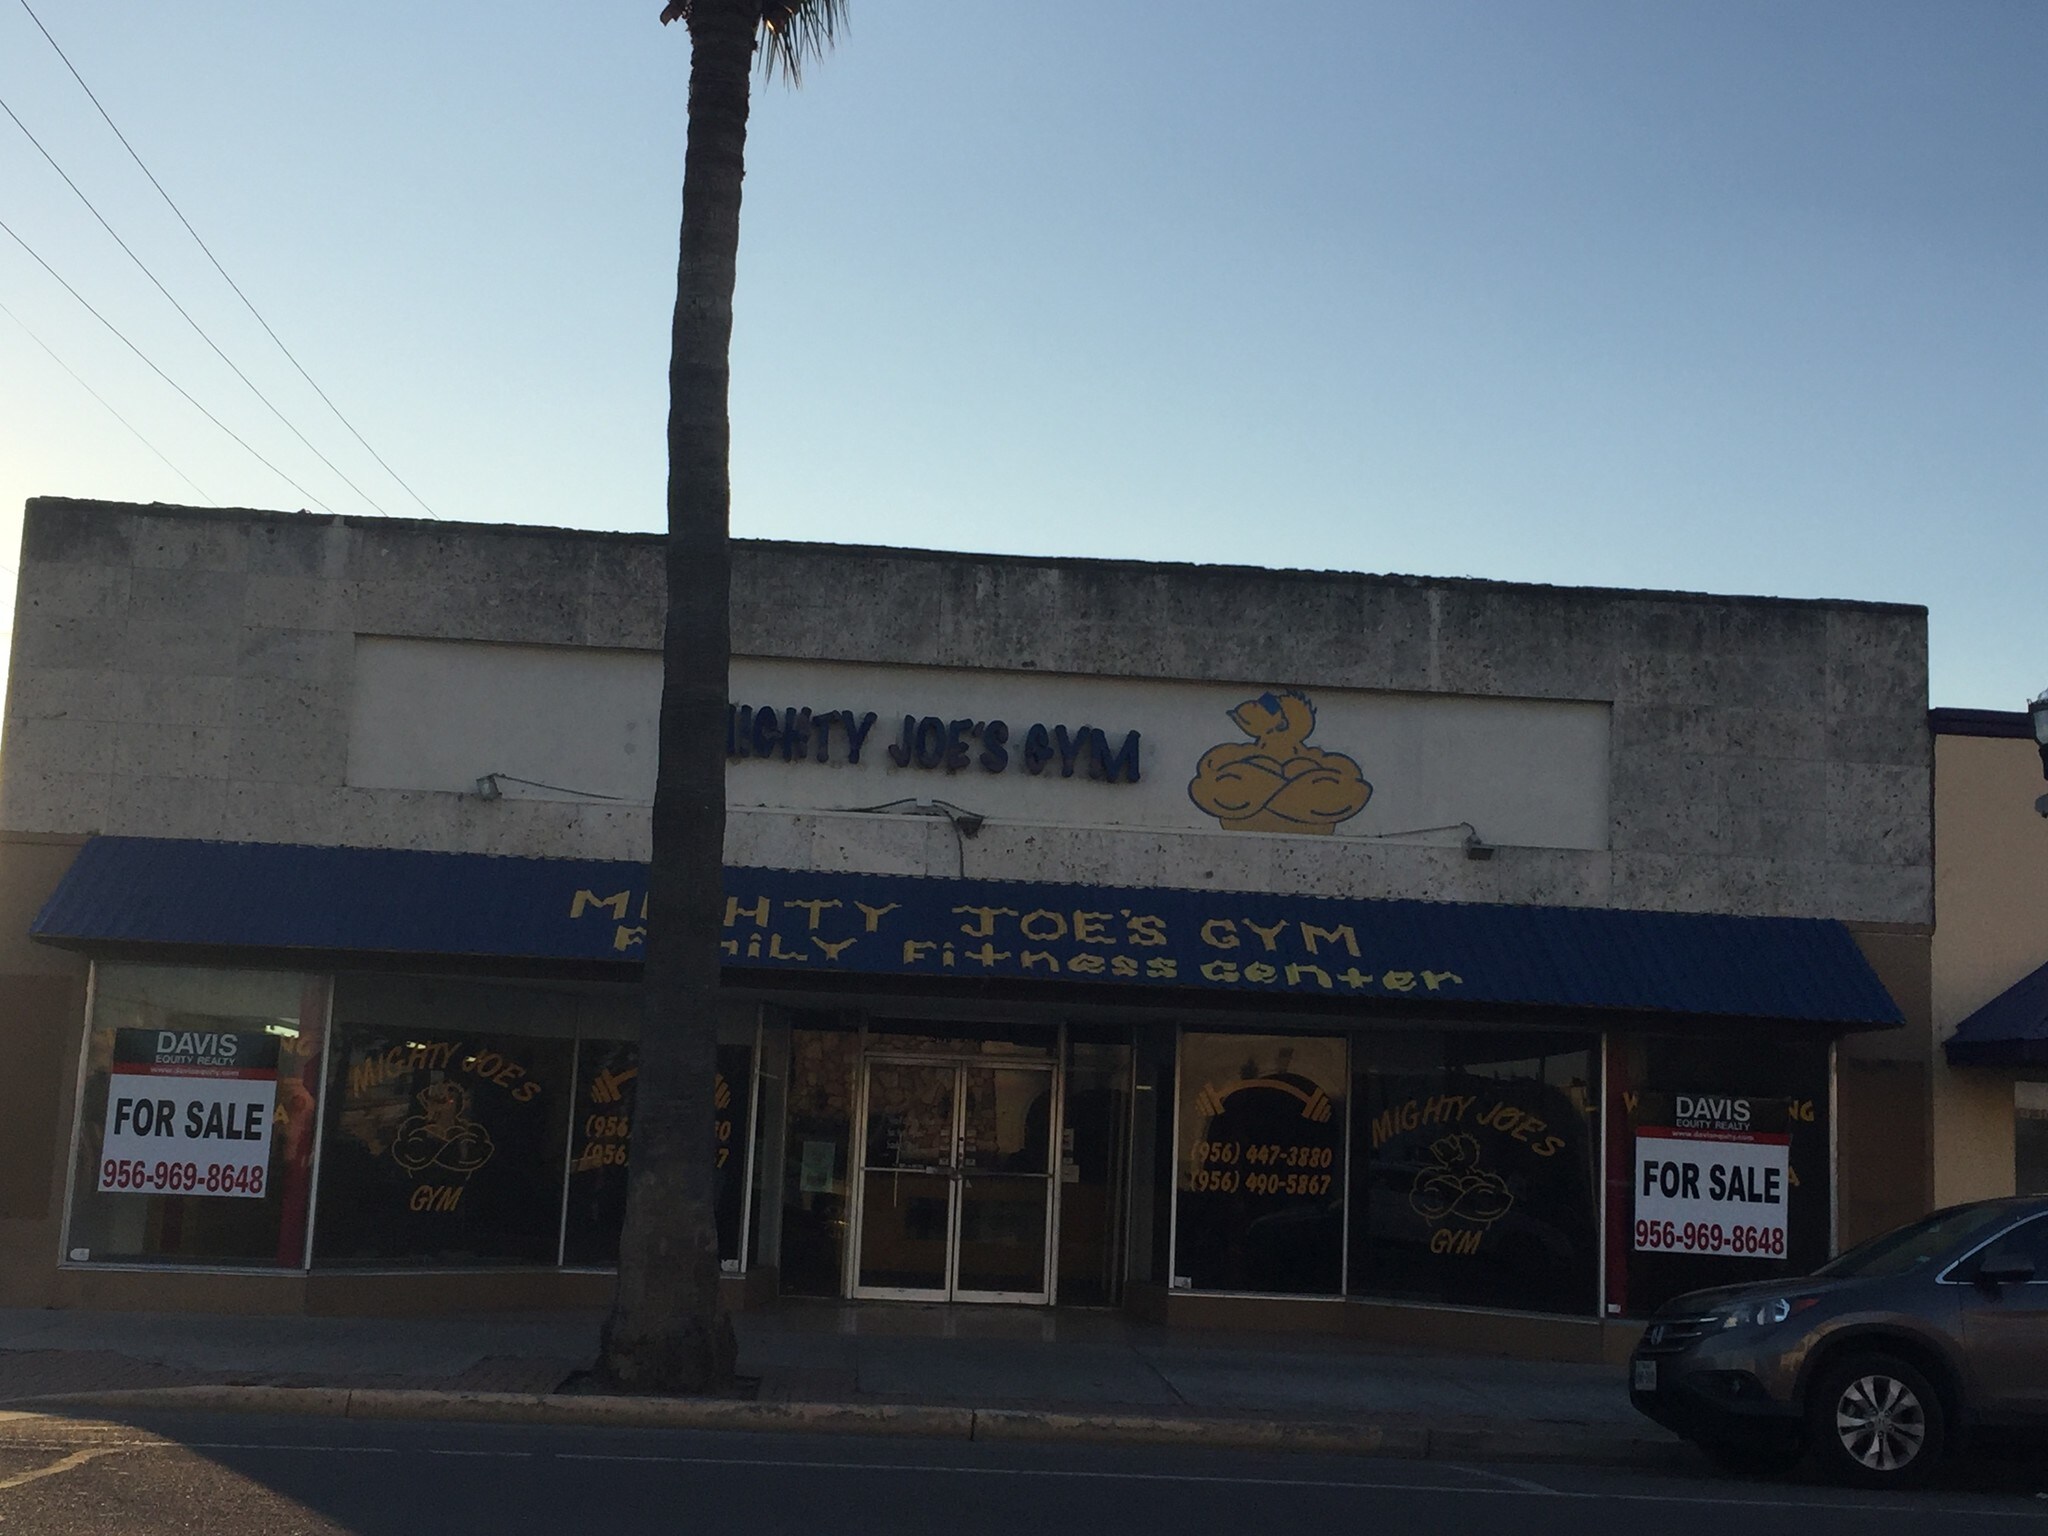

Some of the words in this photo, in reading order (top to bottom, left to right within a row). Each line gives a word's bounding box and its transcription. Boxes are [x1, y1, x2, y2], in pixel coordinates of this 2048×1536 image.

[888, 714, 1010, 774] JOE'S
[1025, 722, 1142, 784] GYM
[569, 888, 903, 932] MHTY
[951, 904, 1168, 946] JOE'S
[1200, 918, 1363, 958] GYM
[156, 1030, 239, 1058] DAVIS
[155, 1054, 194, 1065] EQUITY
[196, 1056, 236, 1066] REALTY
[113, 1098, 177, 1137] FOR
[184, 1100, 265, 1141] SALE
[1675, 1096, 1751, 1123] DAVIS
[1676, 1118, 1712, 1129] EQUITY
[1714, 1120, 1751, 1131] REALTY
[1371, 1094, 1477, 1150] MIGHTY
[1476, 1101, 1566, 1157] JOES
[1246, 1144, 1333, 1169] 447-3880
[102, 1159, 264, 1194] 956-969-8648
[1643, 1160, 1700, 1199] FOR
[1709, 1164, 1780, 1204] SALE
[410, 1184, 464, 1212] GYM
[1430, 1228, 1483, 1255] GYM
[1636, 1219, 1784, 1255] 956-969-8648
